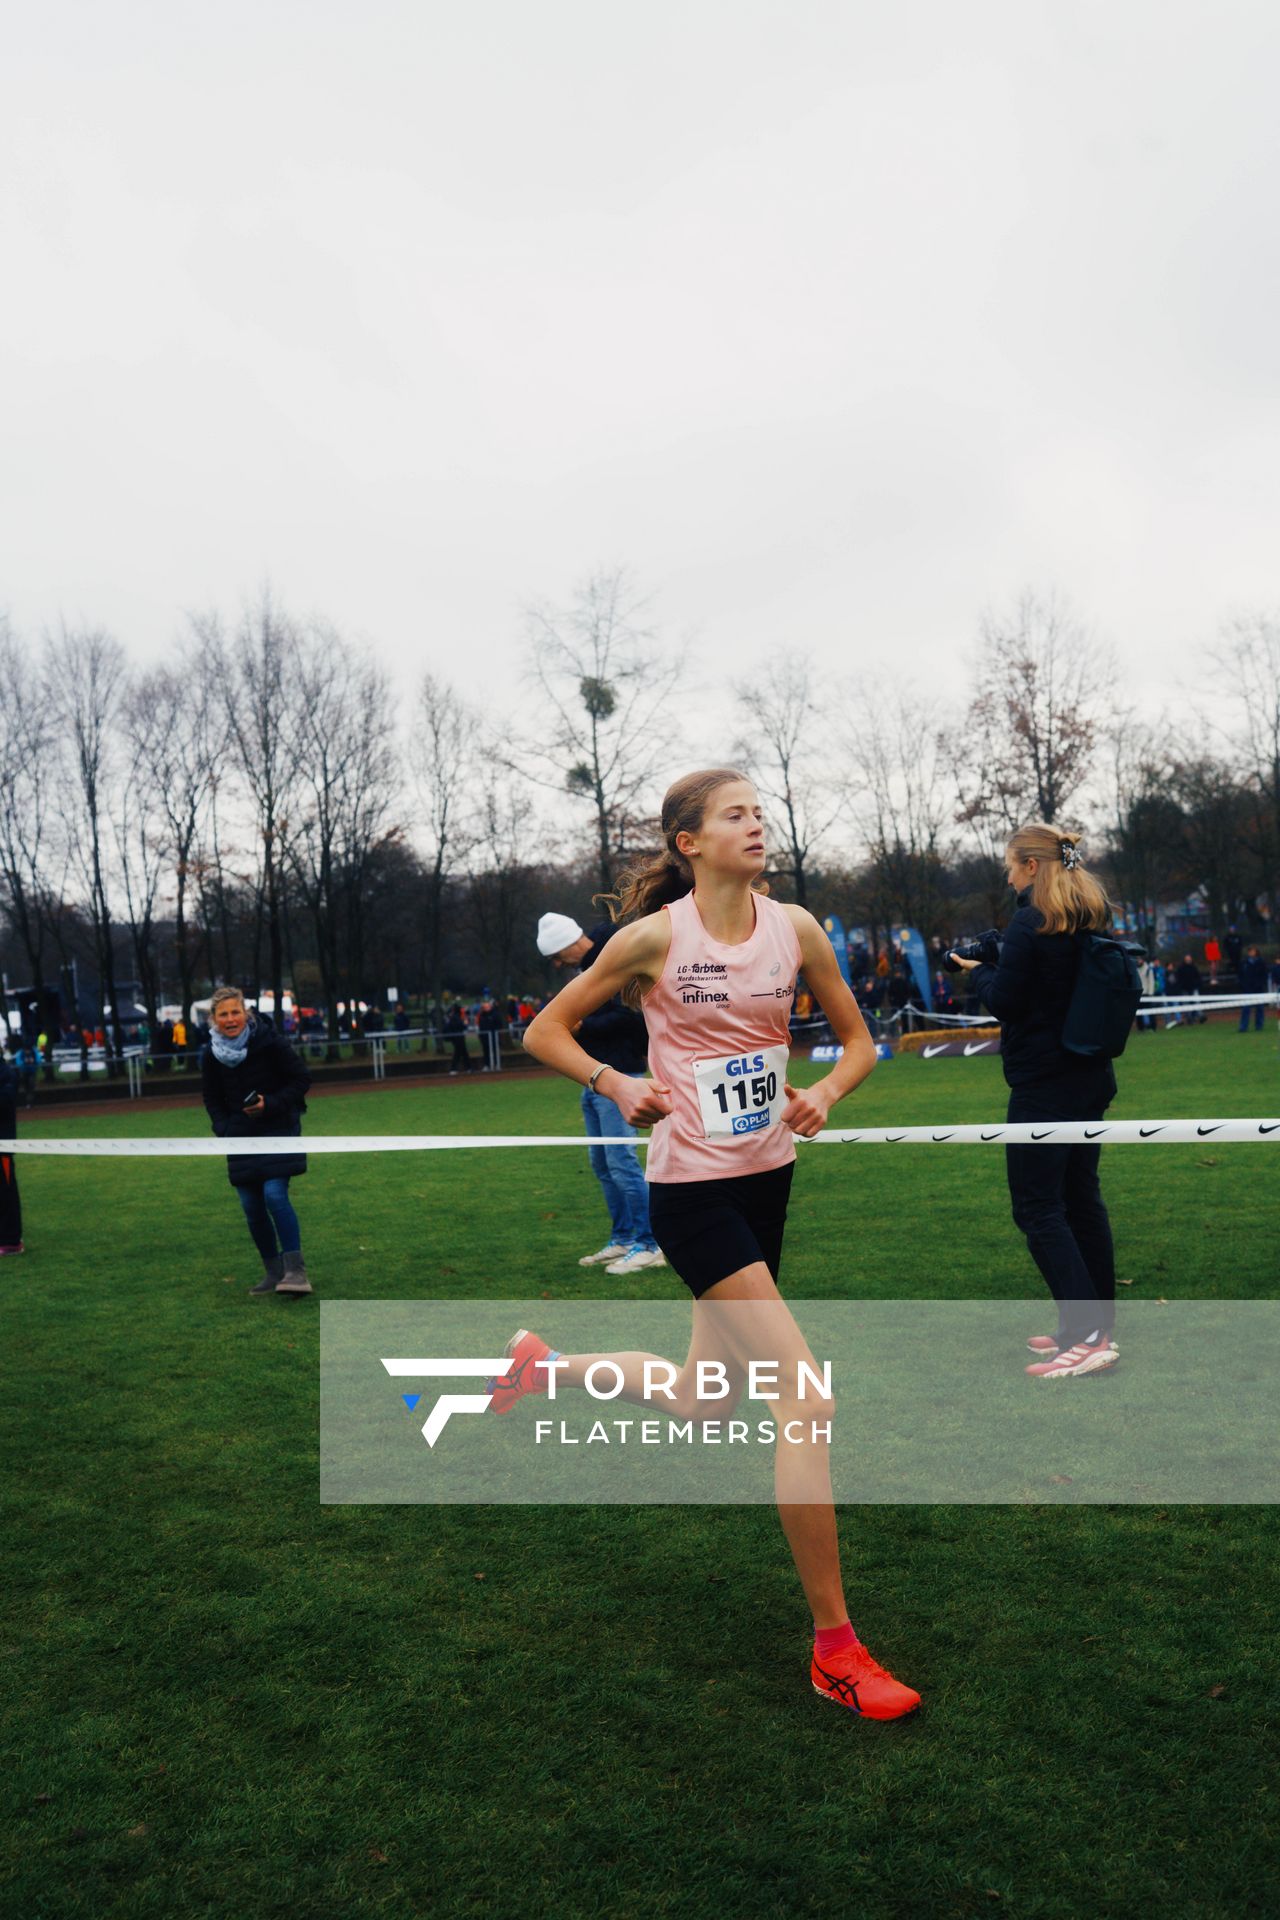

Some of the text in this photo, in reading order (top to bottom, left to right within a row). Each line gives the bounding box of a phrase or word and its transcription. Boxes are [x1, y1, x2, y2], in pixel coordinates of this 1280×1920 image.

[682, 990, 729, 1003] infinex
[712, 1071, 777, 1114] 1150
[749, 1111, 769, 1125] PLAN
